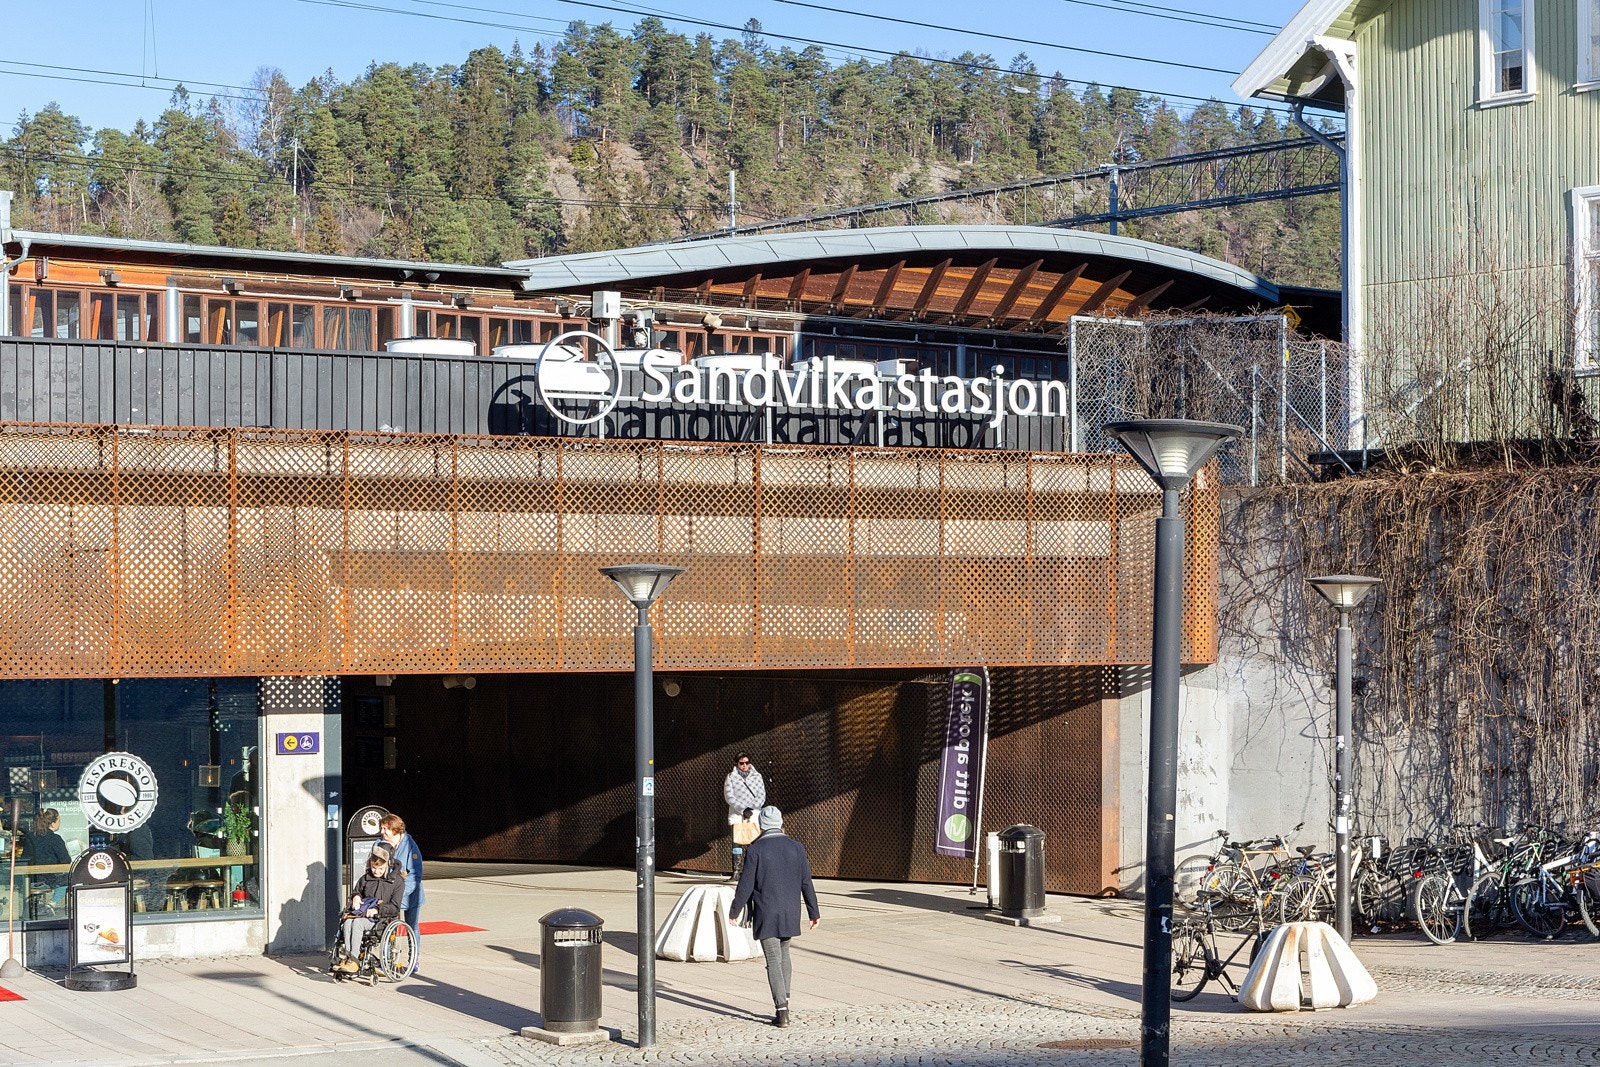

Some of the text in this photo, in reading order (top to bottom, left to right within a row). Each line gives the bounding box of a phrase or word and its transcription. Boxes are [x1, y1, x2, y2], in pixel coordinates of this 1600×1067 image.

[640, 349, 1067, 428] Sandvika stasjon
[86, 758, 150, 787] ESPRESSO
[93, 808, 144, 827] HOUSE
